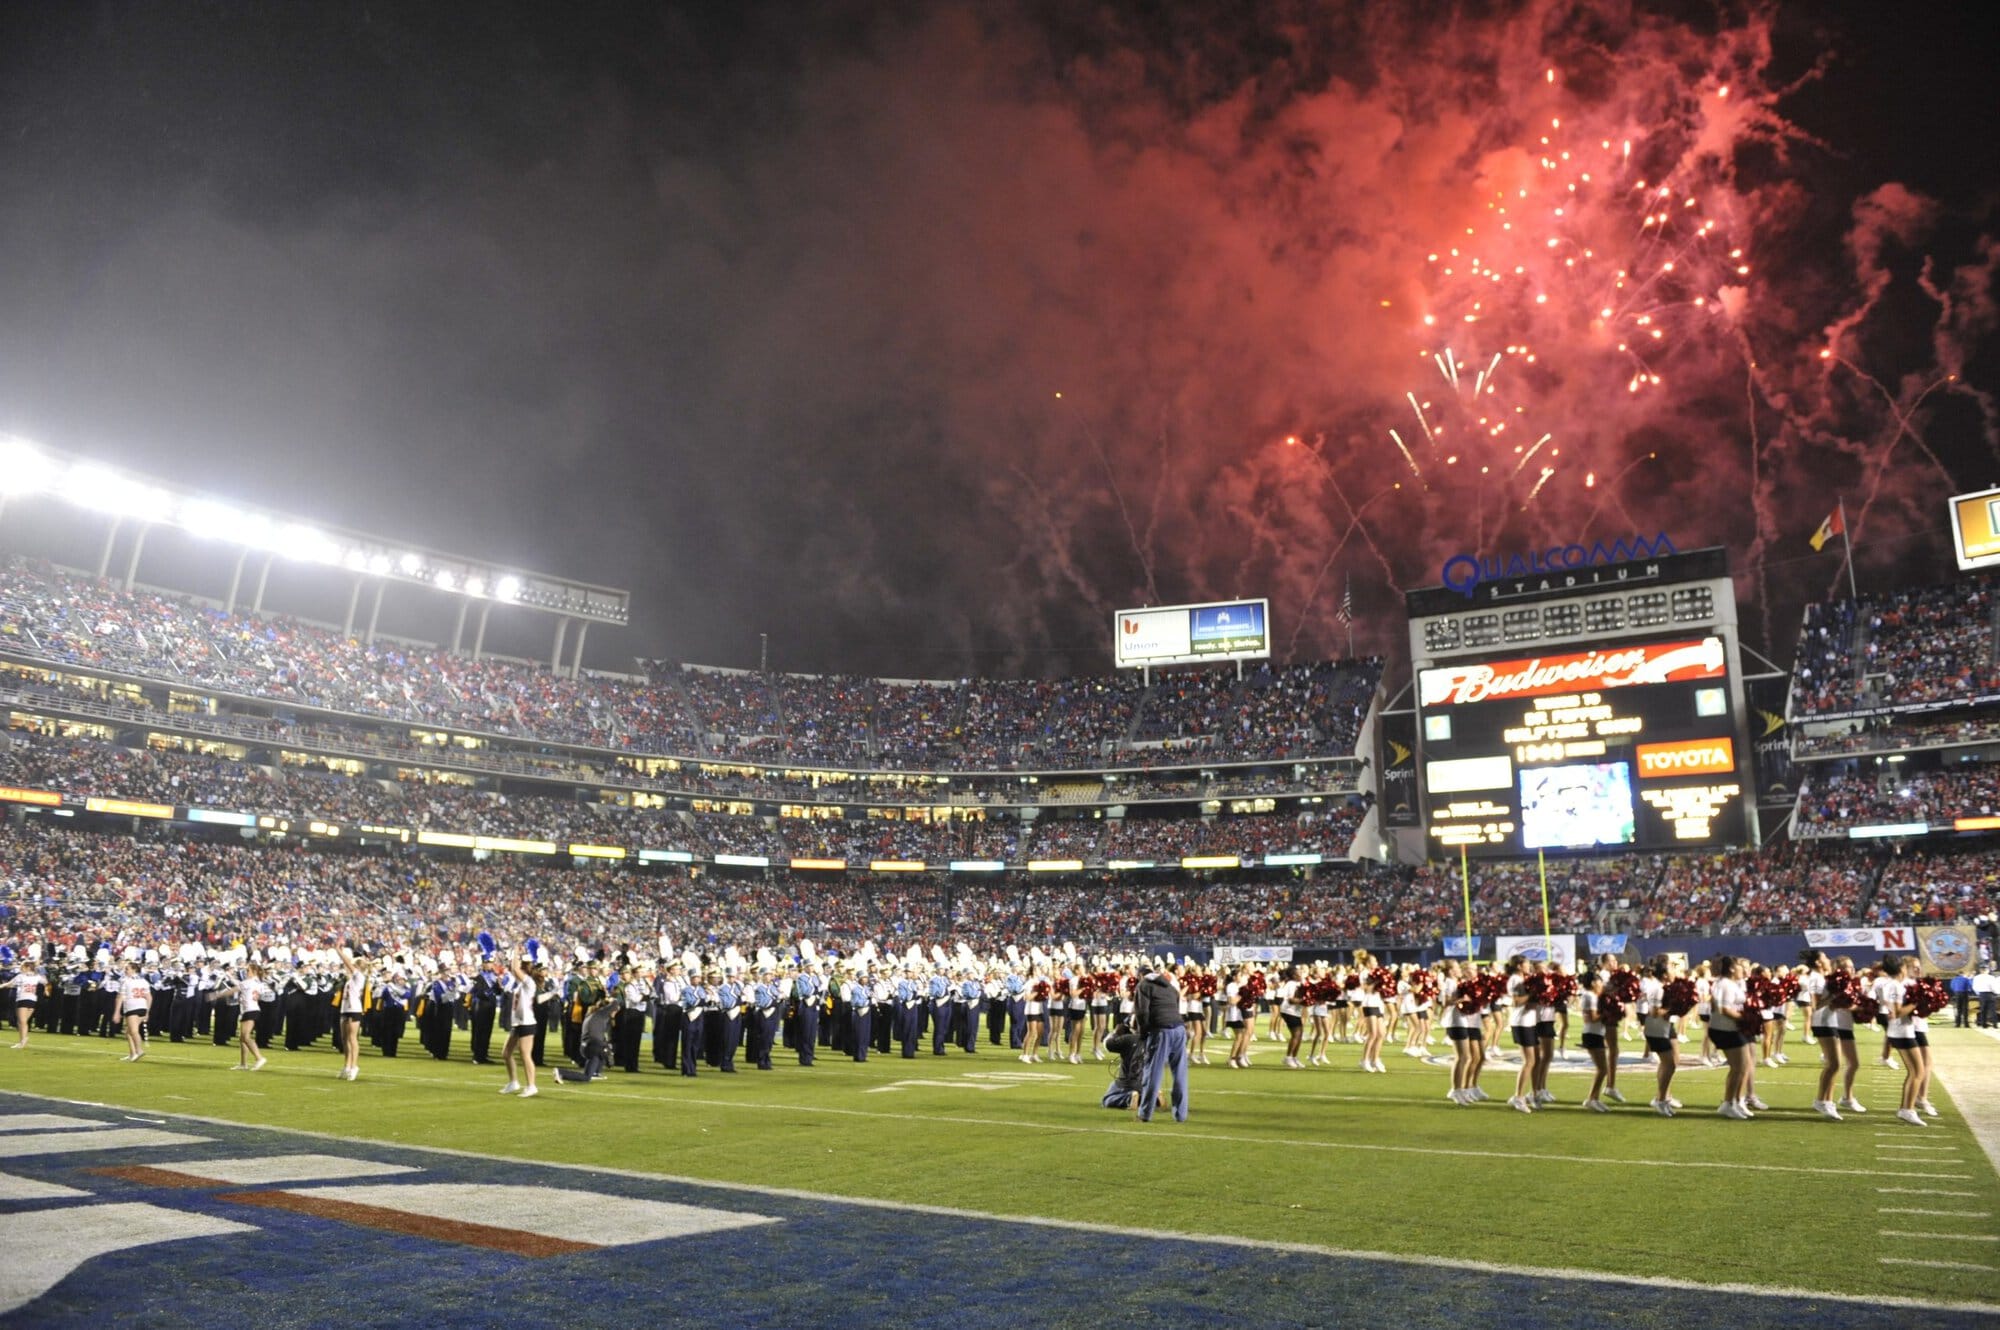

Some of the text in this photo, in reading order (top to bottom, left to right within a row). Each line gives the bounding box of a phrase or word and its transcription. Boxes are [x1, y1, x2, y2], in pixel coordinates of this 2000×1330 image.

[1442, 531, 1677, 598] QUALCOMM
[1490, 564, 1659, 597] STADIUM
[1453, 648, 1646, 703] Budweiser
[1641, 747, 1729, 770] TOYOTA
[1384, 769, 1415, 781] Sprint
[1882, 930, 1906, 949] N
